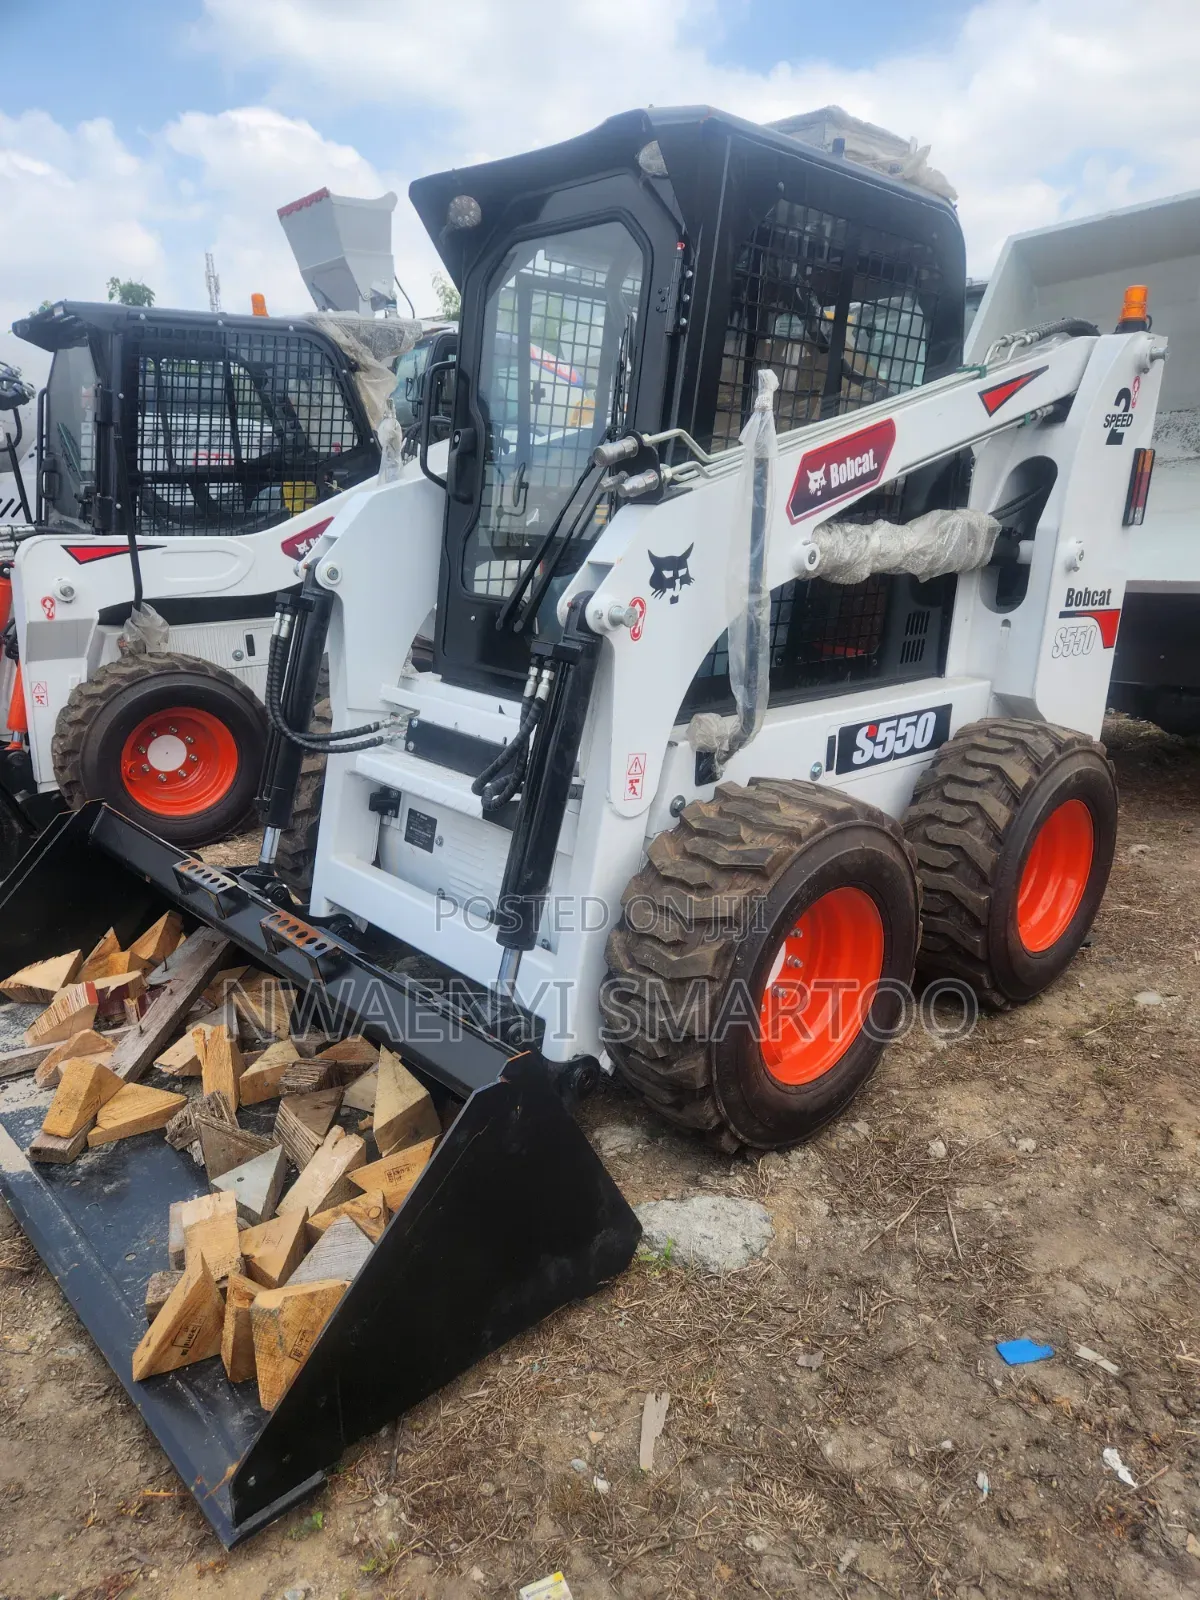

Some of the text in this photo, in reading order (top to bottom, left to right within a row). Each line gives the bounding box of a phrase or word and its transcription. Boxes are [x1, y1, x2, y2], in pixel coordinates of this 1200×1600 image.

[1103, 413, 1133, 428] SPEED
[1105, 387, 1131, 445] 2
[1064, 587, 1112, 607] Bobcat
[1051, 625, 1097, 659] S550
[852, 711, 937, 765] S550
